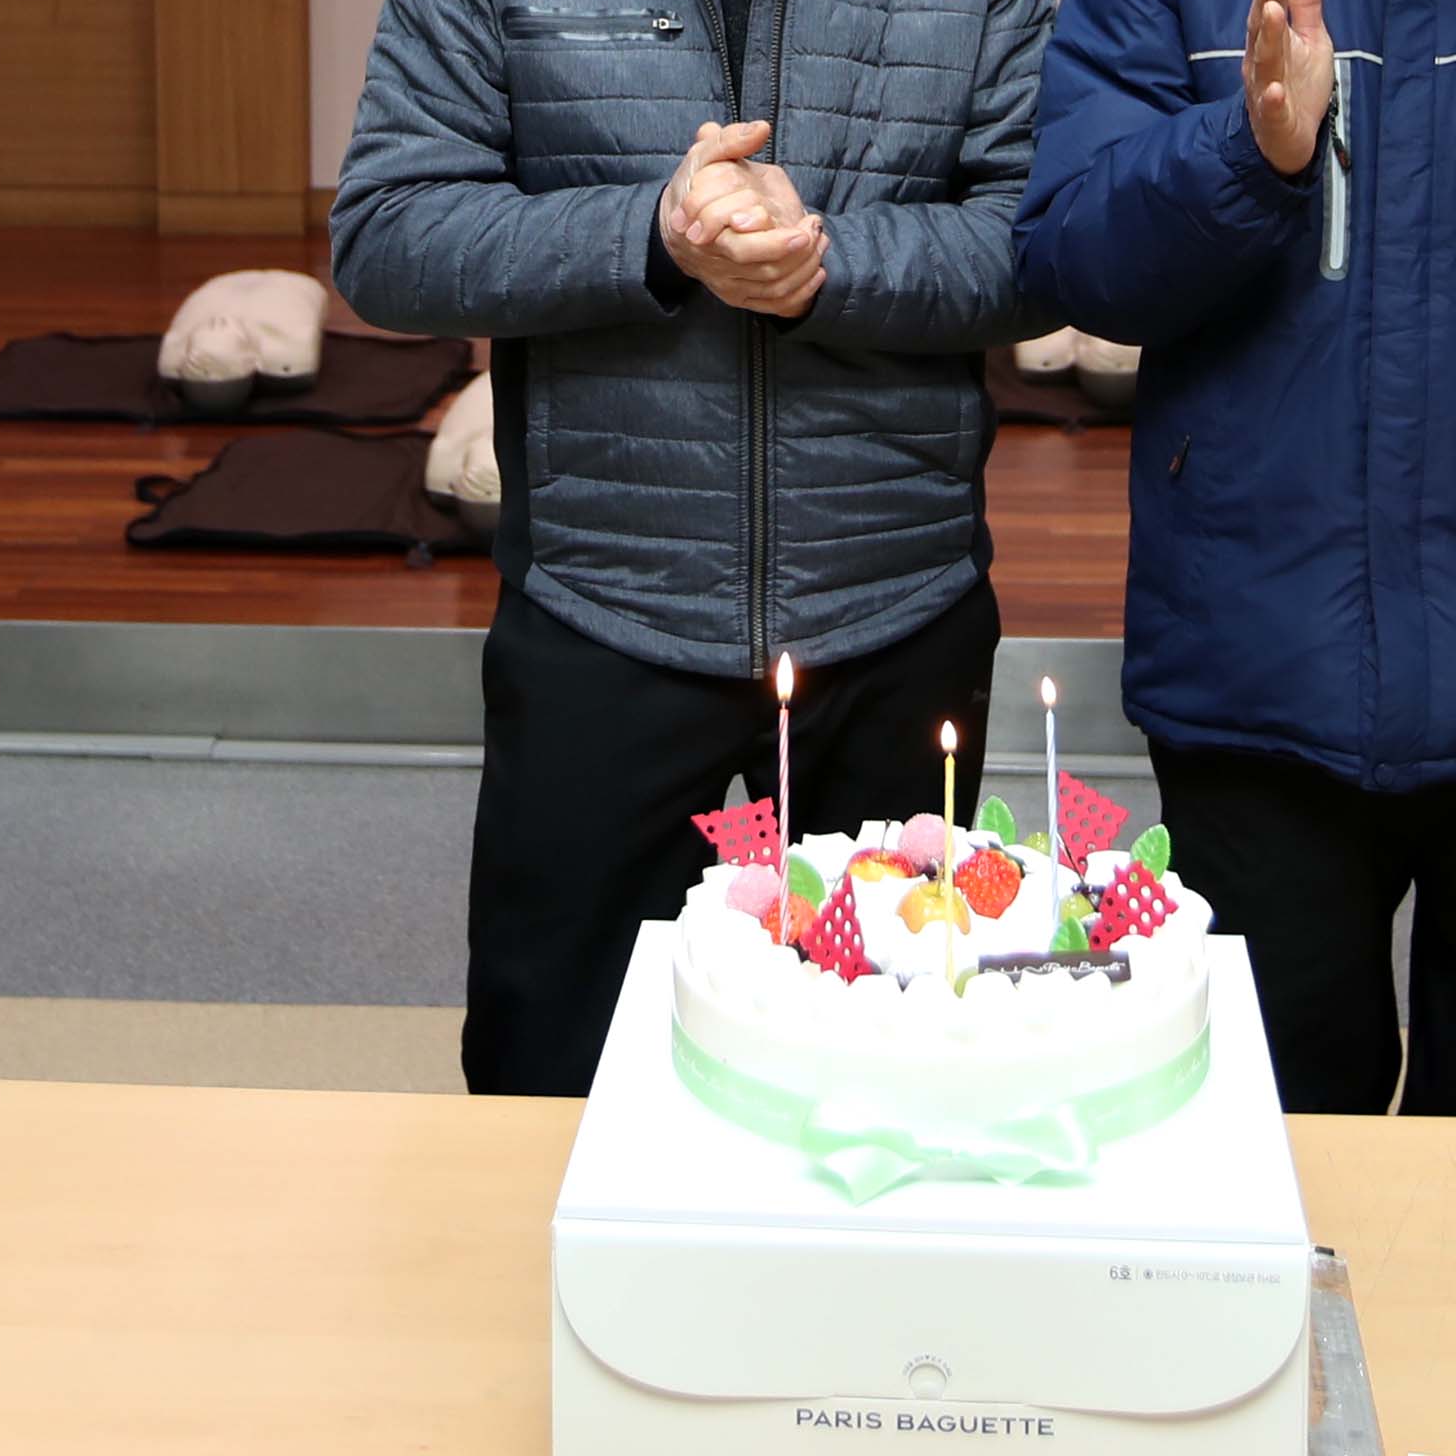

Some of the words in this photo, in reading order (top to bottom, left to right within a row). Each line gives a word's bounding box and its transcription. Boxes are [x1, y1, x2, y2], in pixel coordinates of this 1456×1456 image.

[1109, 1265, 1132, 1281] 6호
[796, 1408, 883, 1430] PARIS
[897, 1413, 1055, 1437] BAGUETTE
